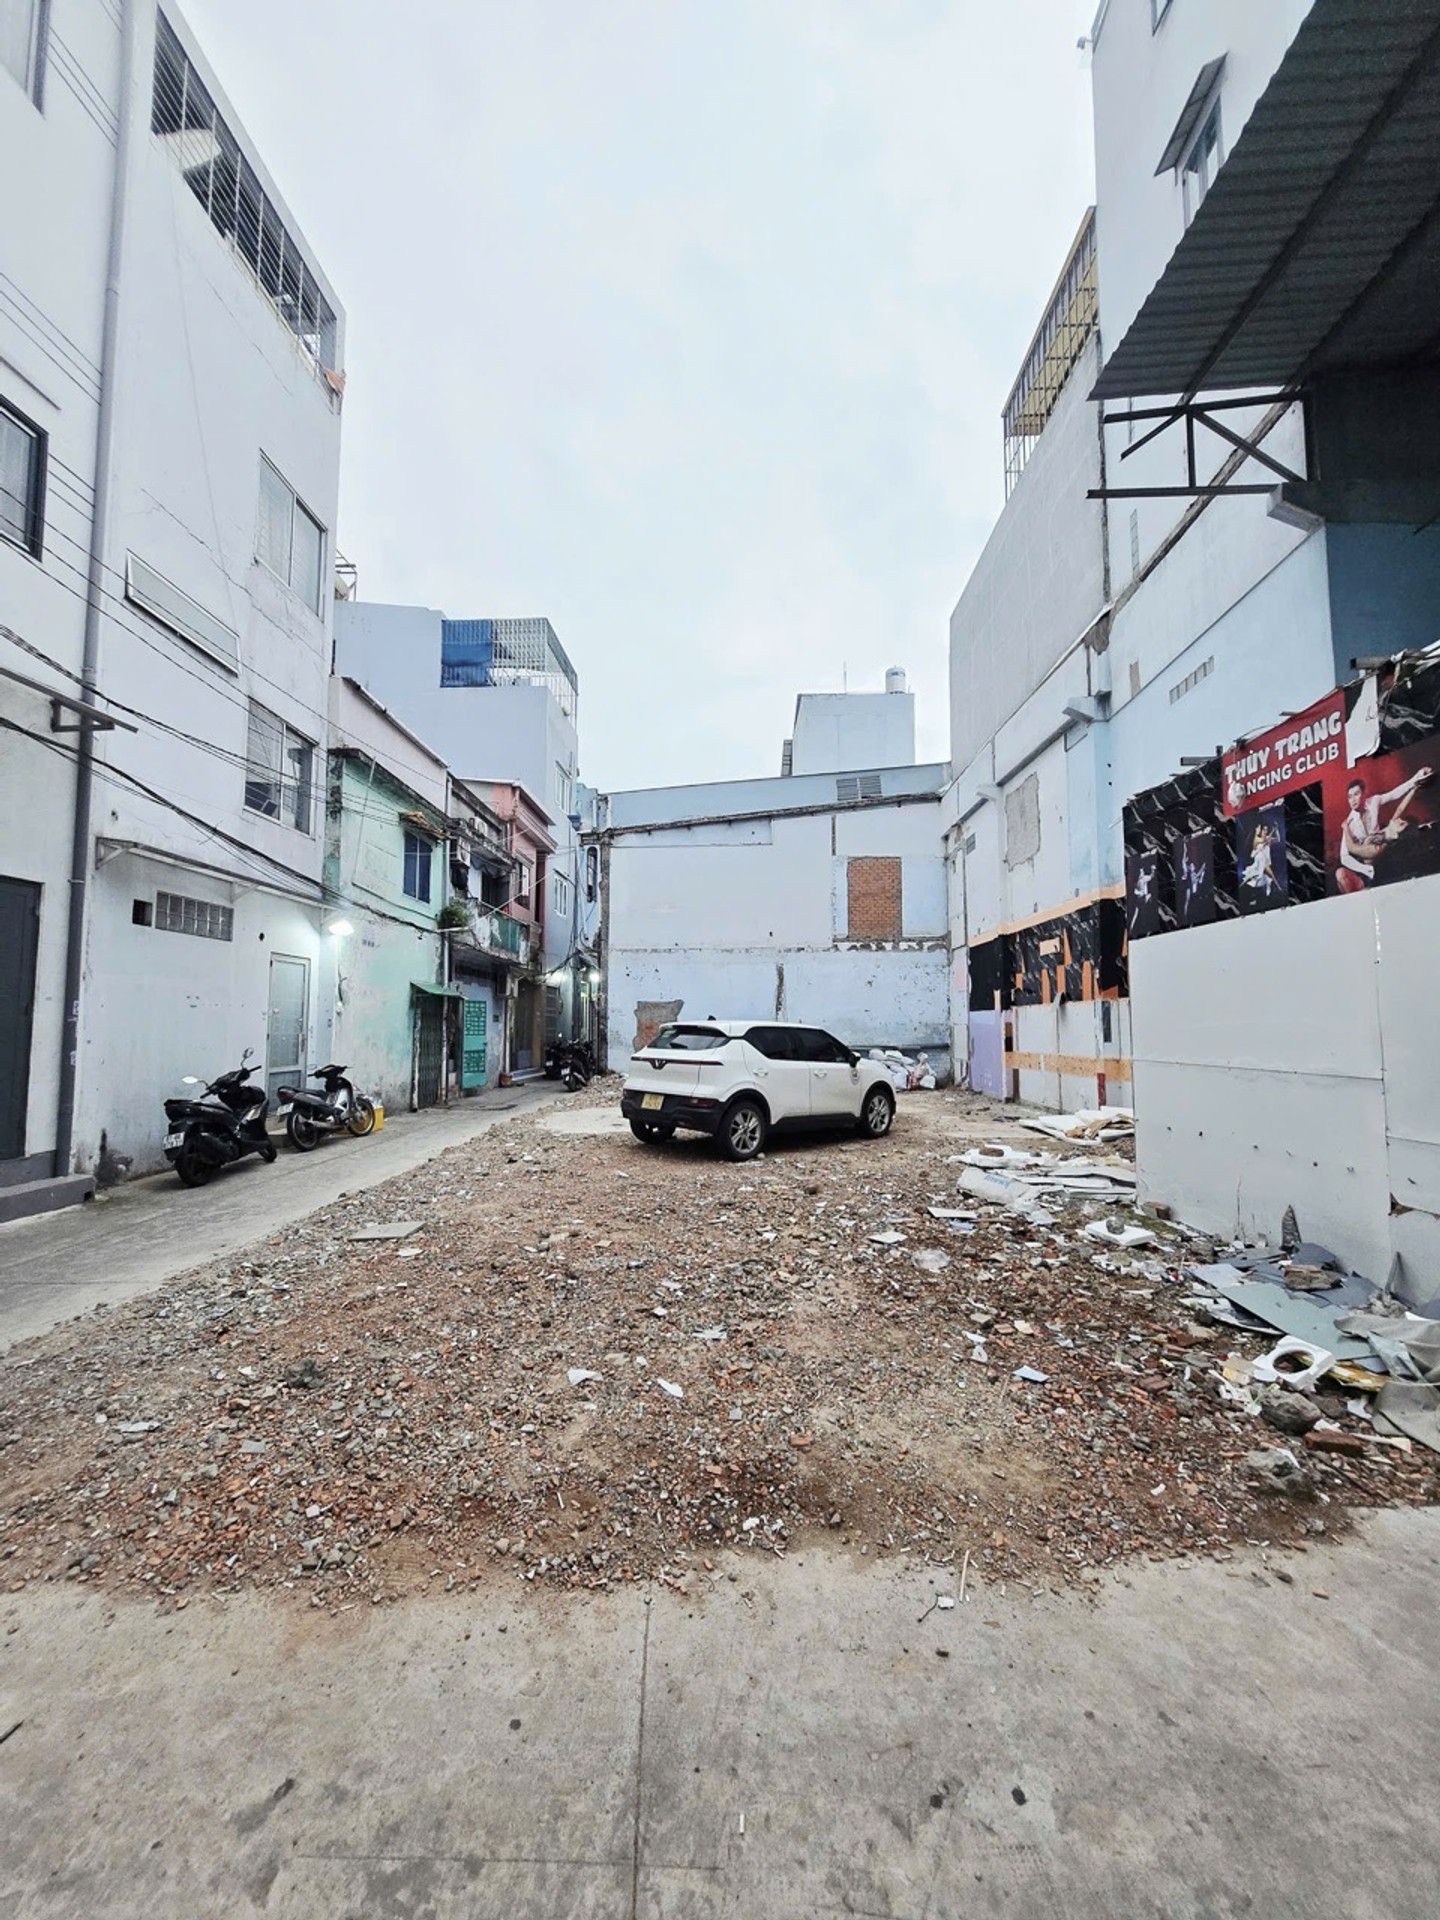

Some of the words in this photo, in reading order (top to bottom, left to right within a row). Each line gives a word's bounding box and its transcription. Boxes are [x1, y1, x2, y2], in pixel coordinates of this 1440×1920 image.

[1274, 711, 1342, 761] TRANG
[1230, 764, 1292, 799] NCING
[1295, 742, 1339, 774] CLUB
